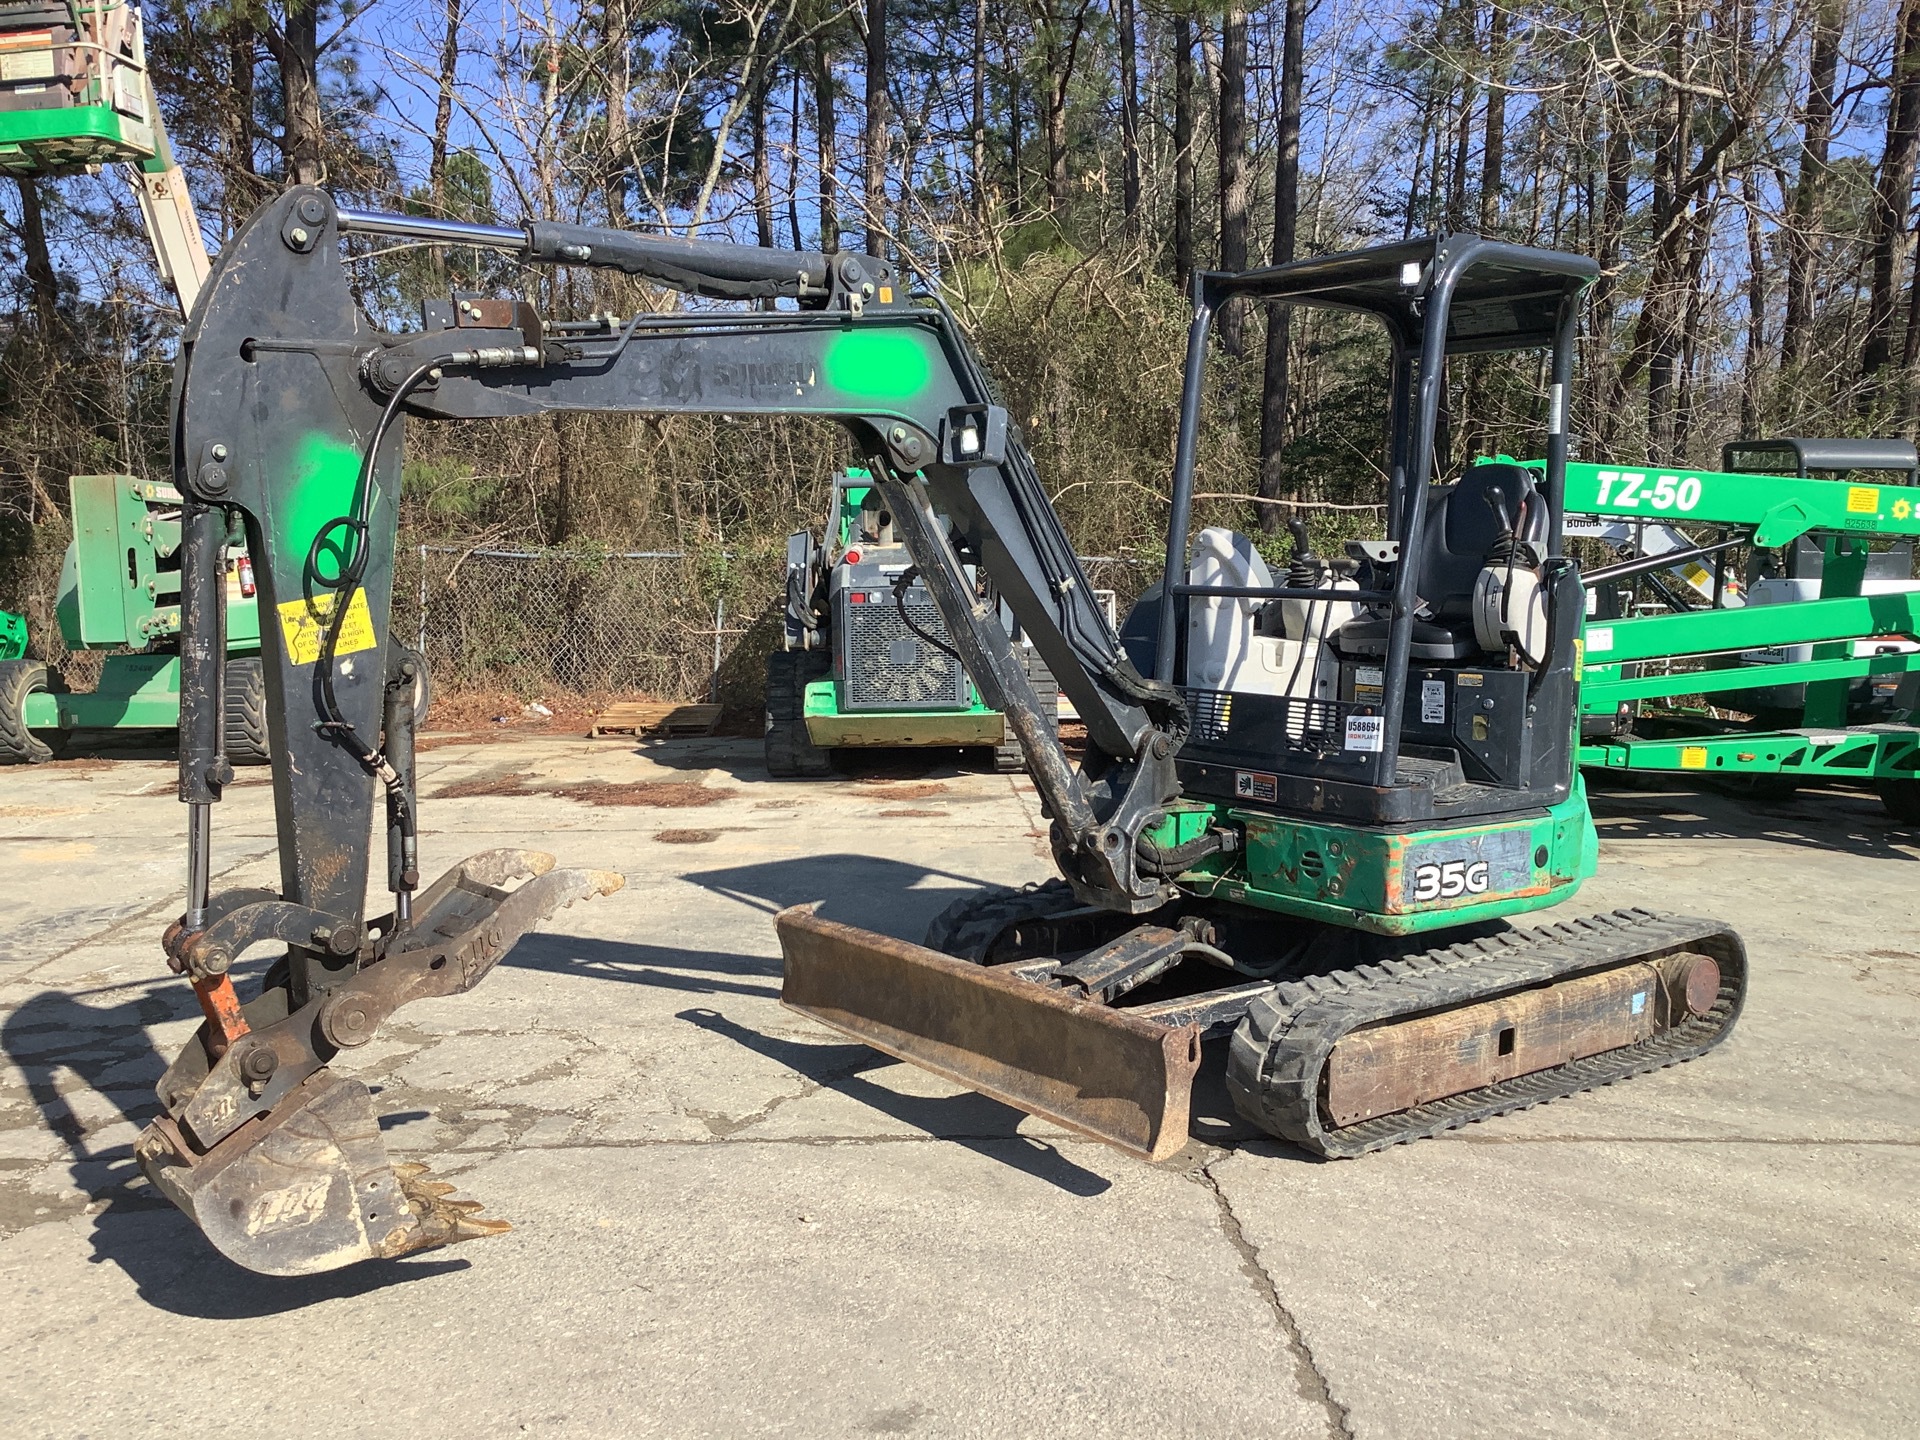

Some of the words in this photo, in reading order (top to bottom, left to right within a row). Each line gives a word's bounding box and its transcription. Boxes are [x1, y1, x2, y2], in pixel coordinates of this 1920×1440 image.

[1596, 471, 1702, 511] TZ-50
[339, 639, 359, 648] LINES
[1348, 721, 1380, 732] U588694
[1413, 859, 1489, 902] 35G
